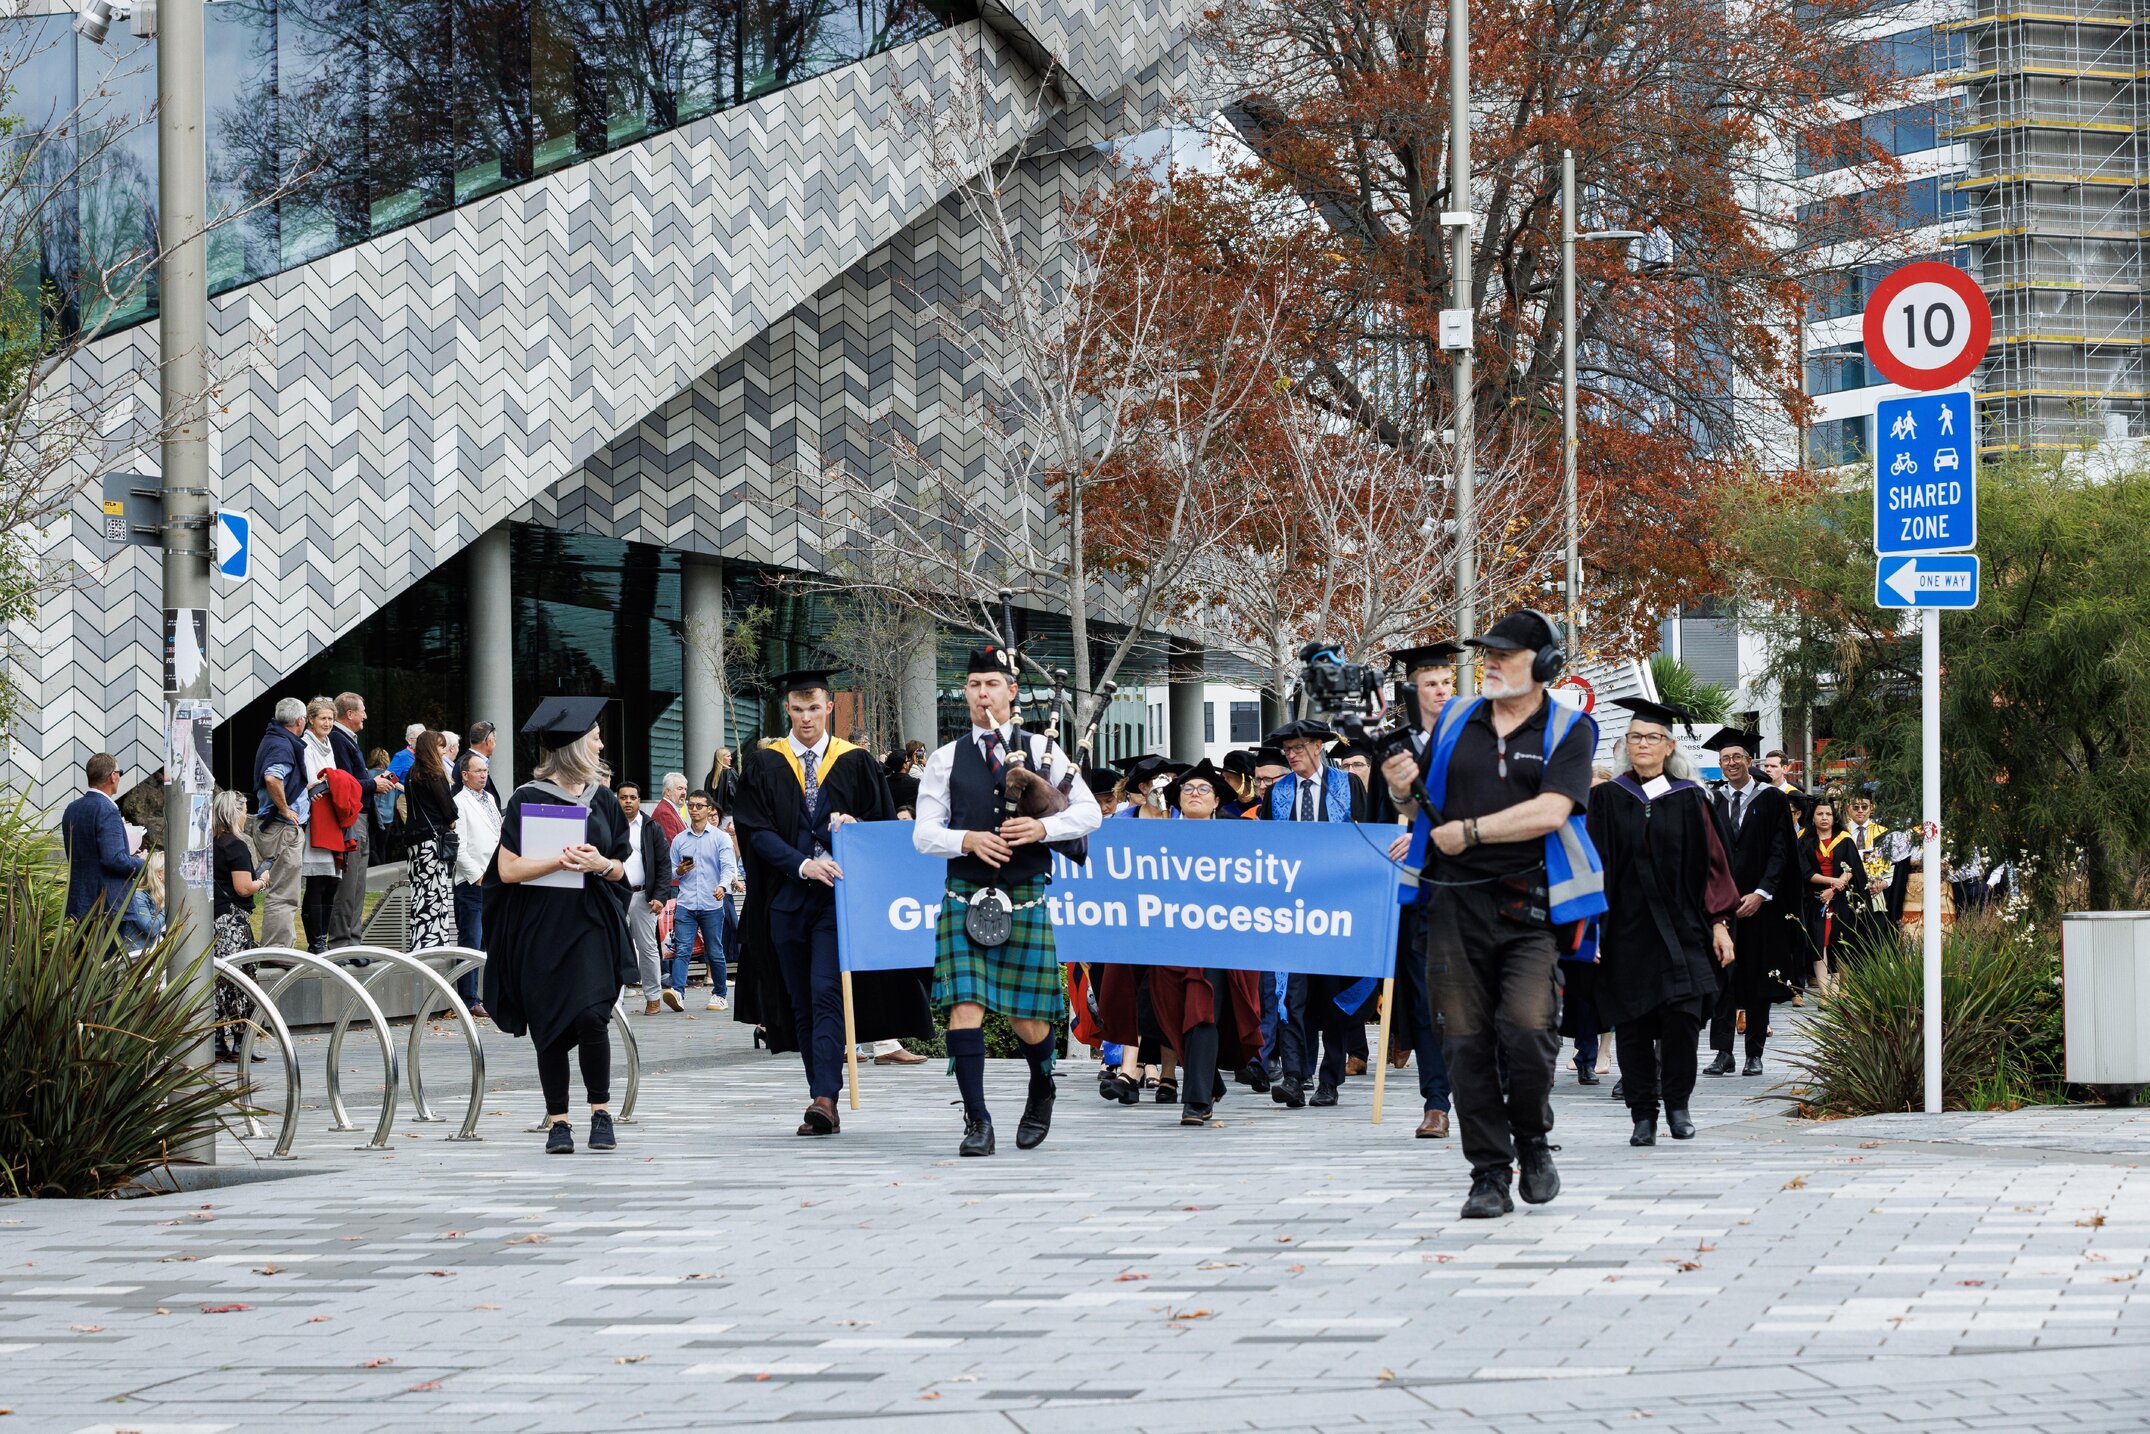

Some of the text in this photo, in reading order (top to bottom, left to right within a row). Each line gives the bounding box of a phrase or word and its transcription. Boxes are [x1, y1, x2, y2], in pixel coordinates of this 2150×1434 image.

[1903, 302, 1955, 348] 10
[1889, 481, 1961, 511] SHARED
[1900, 514, 1950, 541] ZONE
[1919, 575, 1966, 587] ONE WAY
[1106, 846, 1302, 893] University
[888, 891, 1353, 937] Grtion Procession
